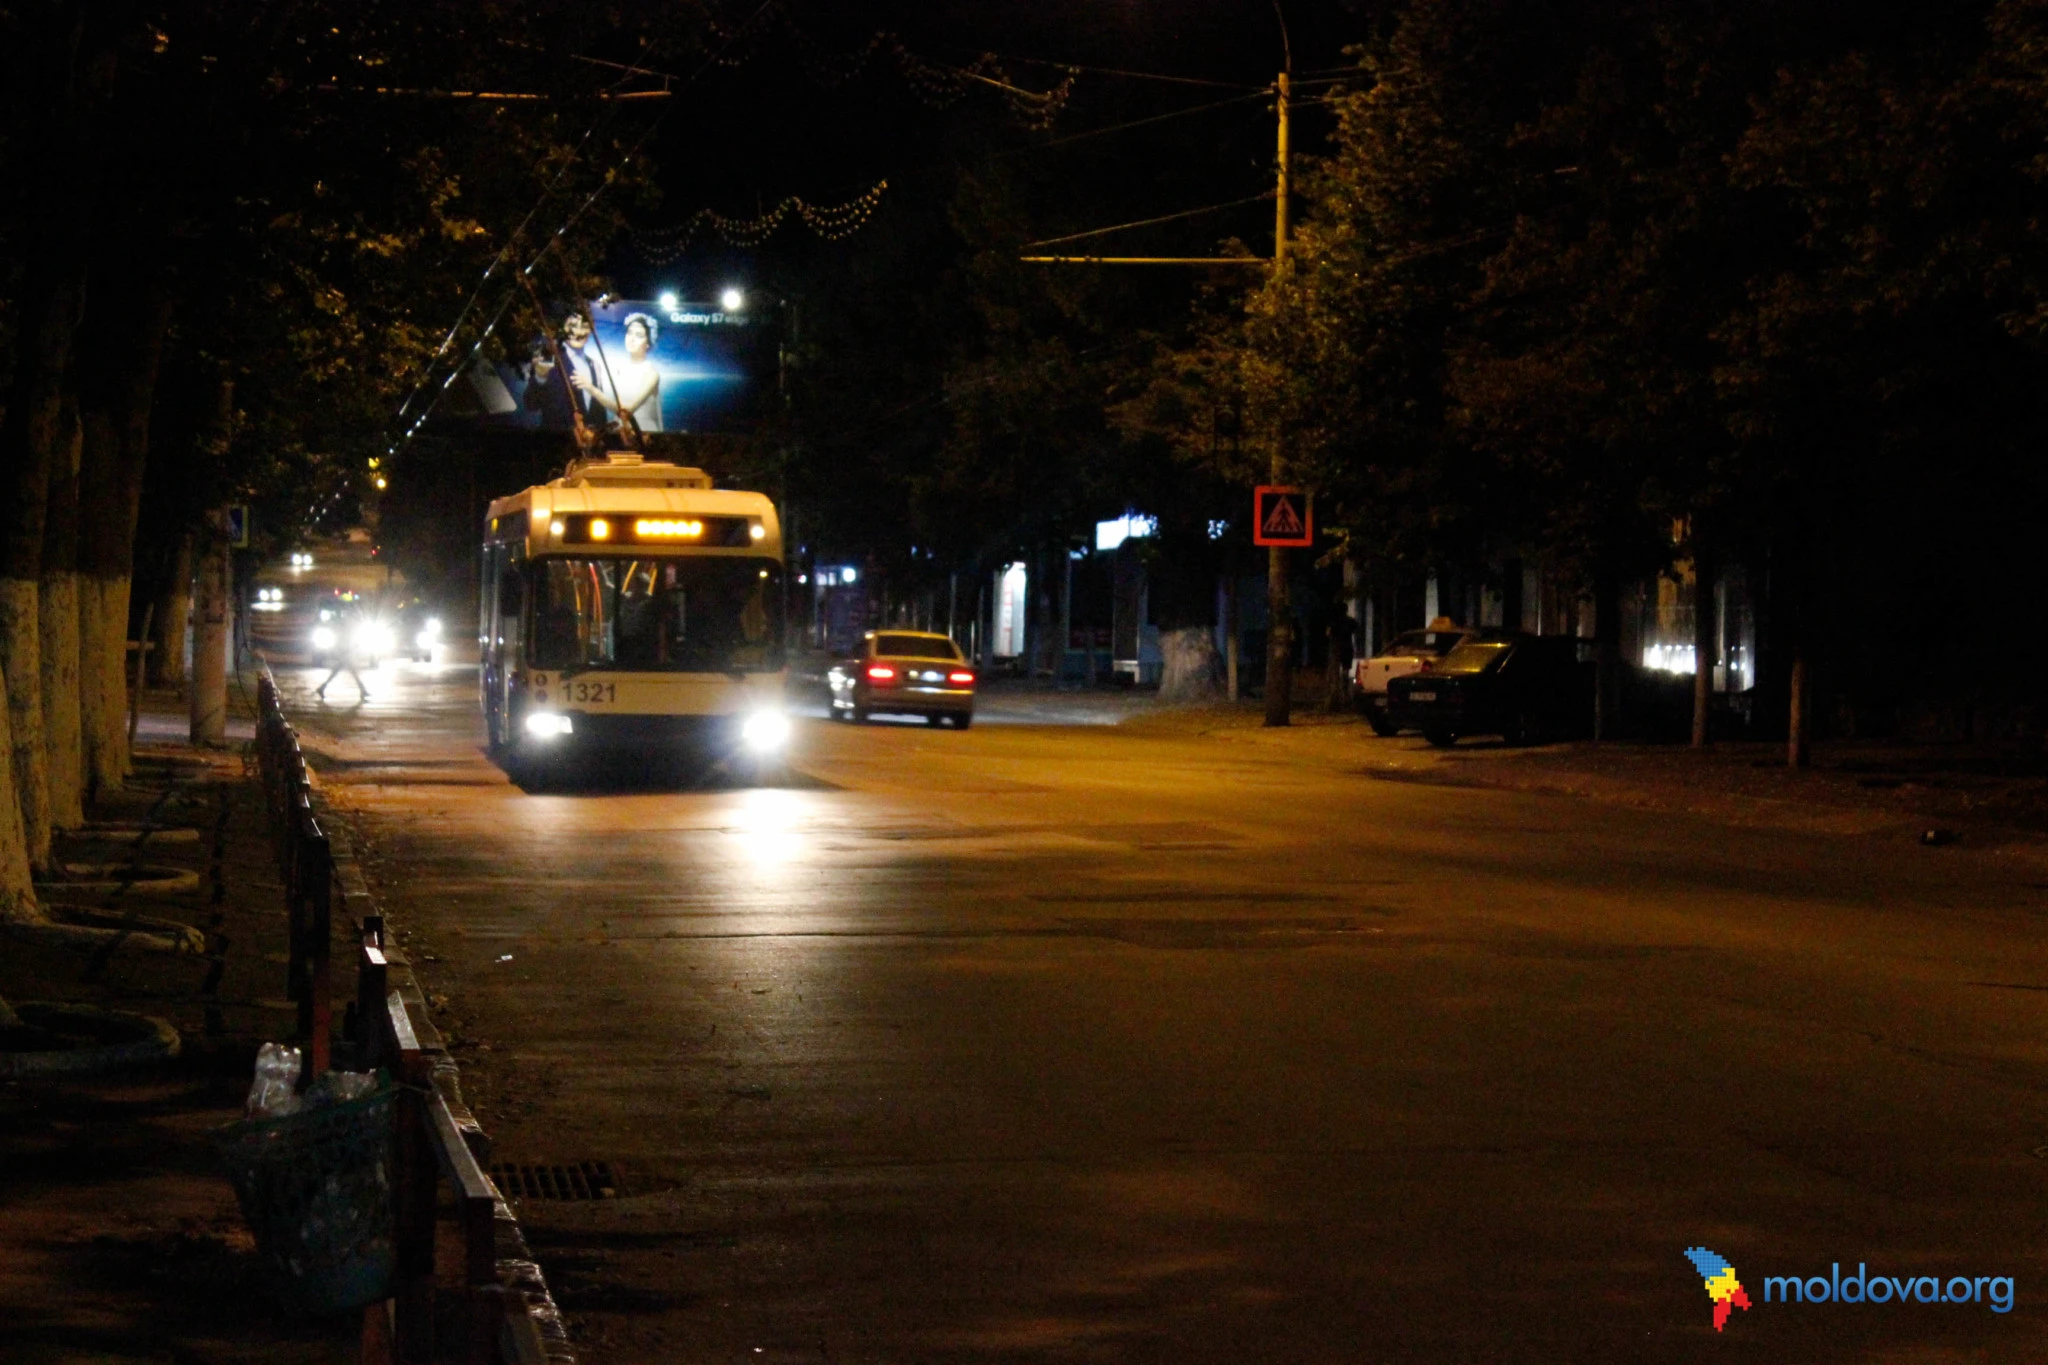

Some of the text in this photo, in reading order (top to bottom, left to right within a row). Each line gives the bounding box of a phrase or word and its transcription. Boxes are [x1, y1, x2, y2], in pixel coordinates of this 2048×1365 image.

[670, 312, 710, 326] Galaxy
[711, 312, 724, 323] S7
[562, 682, 616, 703] 1321
